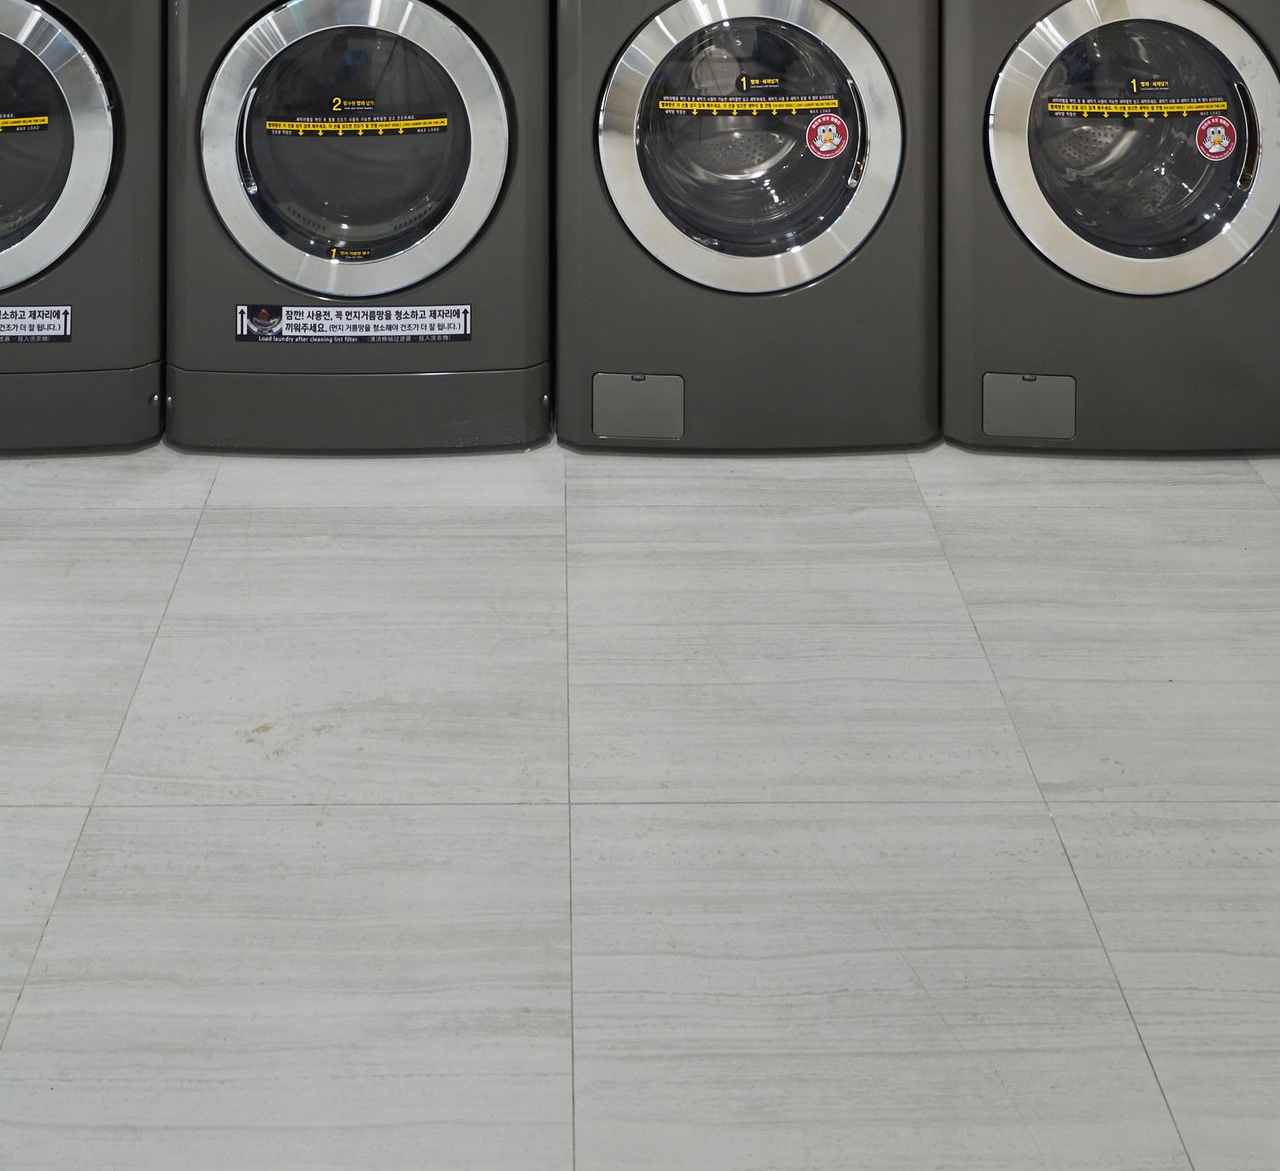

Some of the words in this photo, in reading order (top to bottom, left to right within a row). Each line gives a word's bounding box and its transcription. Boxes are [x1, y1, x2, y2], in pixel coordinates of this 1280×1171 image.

[740, 76, 747, 91] 1
[1130, 78, 1137, 92] 1
[332, 97, 342, 111] 2
[28, 309, 61, 320] 제자리에
[285, 310, 304, 321] 잠깐!
[306, 310, 333, 321] 사용전,
[335, 311, 343, 320] 꼭
[345, 310, 392, 321] 먼지거름망을
[394, 310, 426, 320] 청소하고
[429, 309, 460, 319] 제자리에
[0, 324, 18, 332] 건조가
[28, 323, 35, 331] 잘
[285, 323, 328, 333] 끼워주세요.
[373, 324, 398, 332] 청소해야
[400, 323, 419, 331] 건조가
[420, 323, 427, 331] 더
[429, 323, 435, 331] 잘
